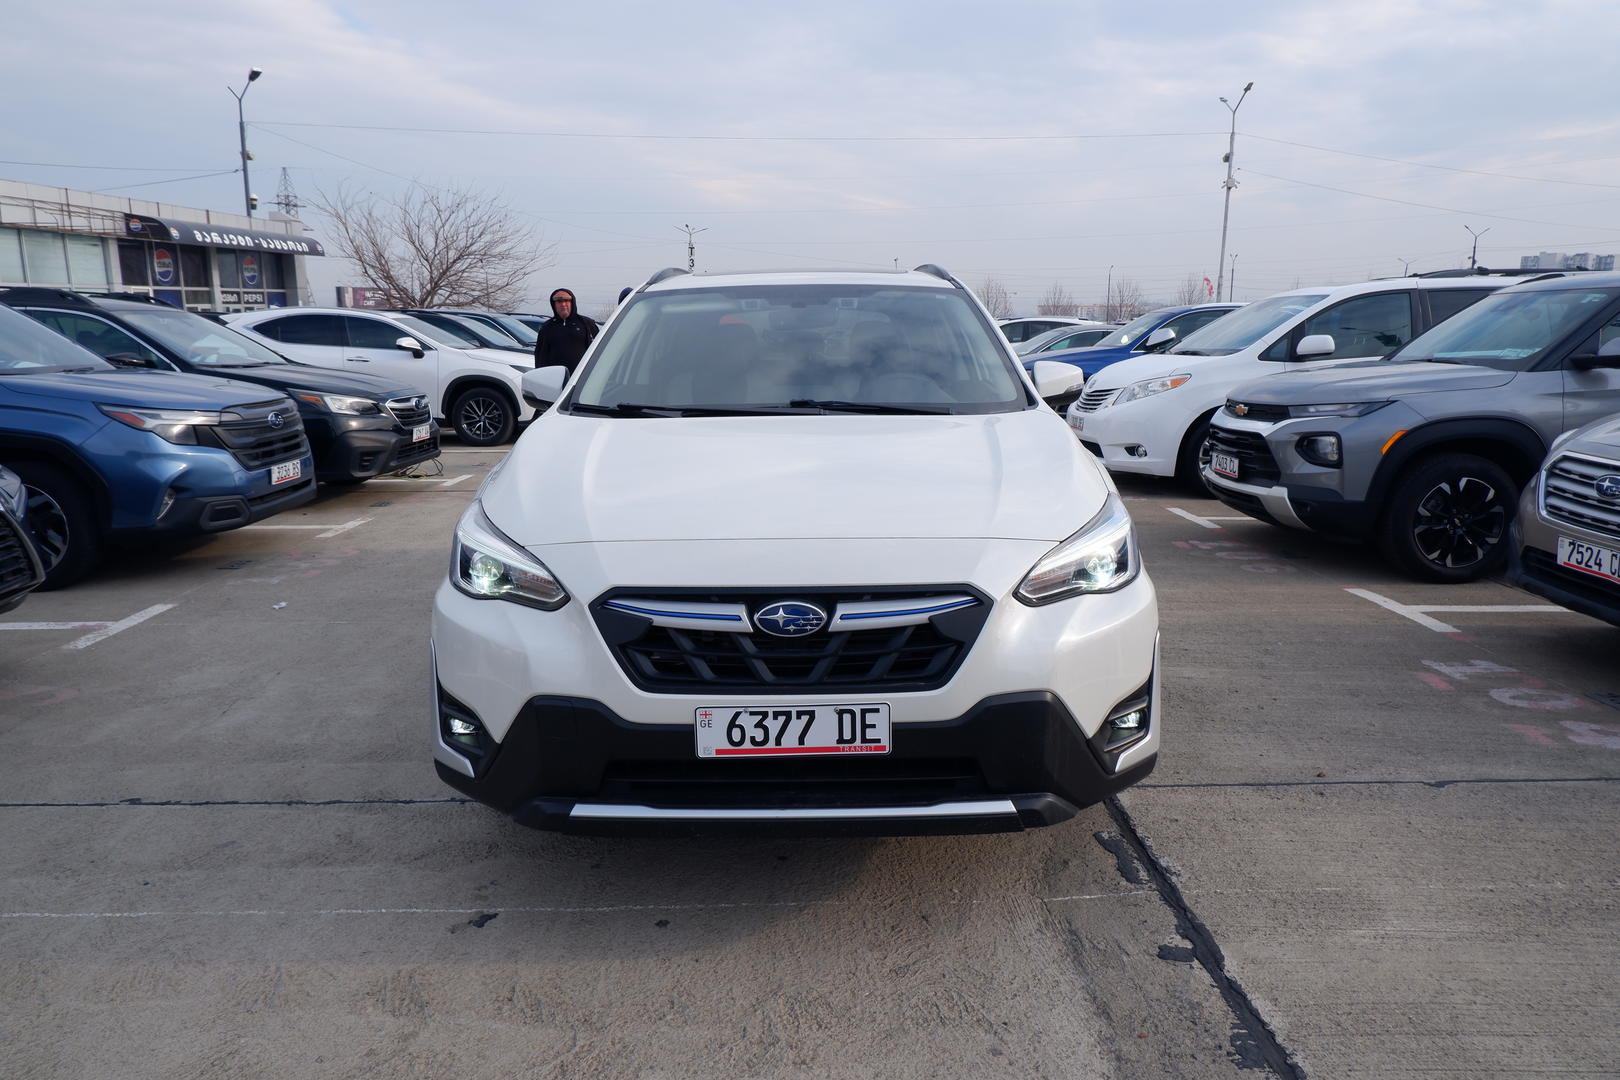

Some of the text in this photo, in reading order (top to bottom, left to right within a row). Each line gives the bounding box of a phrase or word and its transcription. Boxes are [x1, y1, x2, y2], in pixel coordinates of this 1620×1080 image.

[244, 294, 263, 302] PEPSI
[1567, 541, 1603, 571] 7524
[700, 720, 713, 728] GE
[726, 707, 881, 747] 6377 DE
